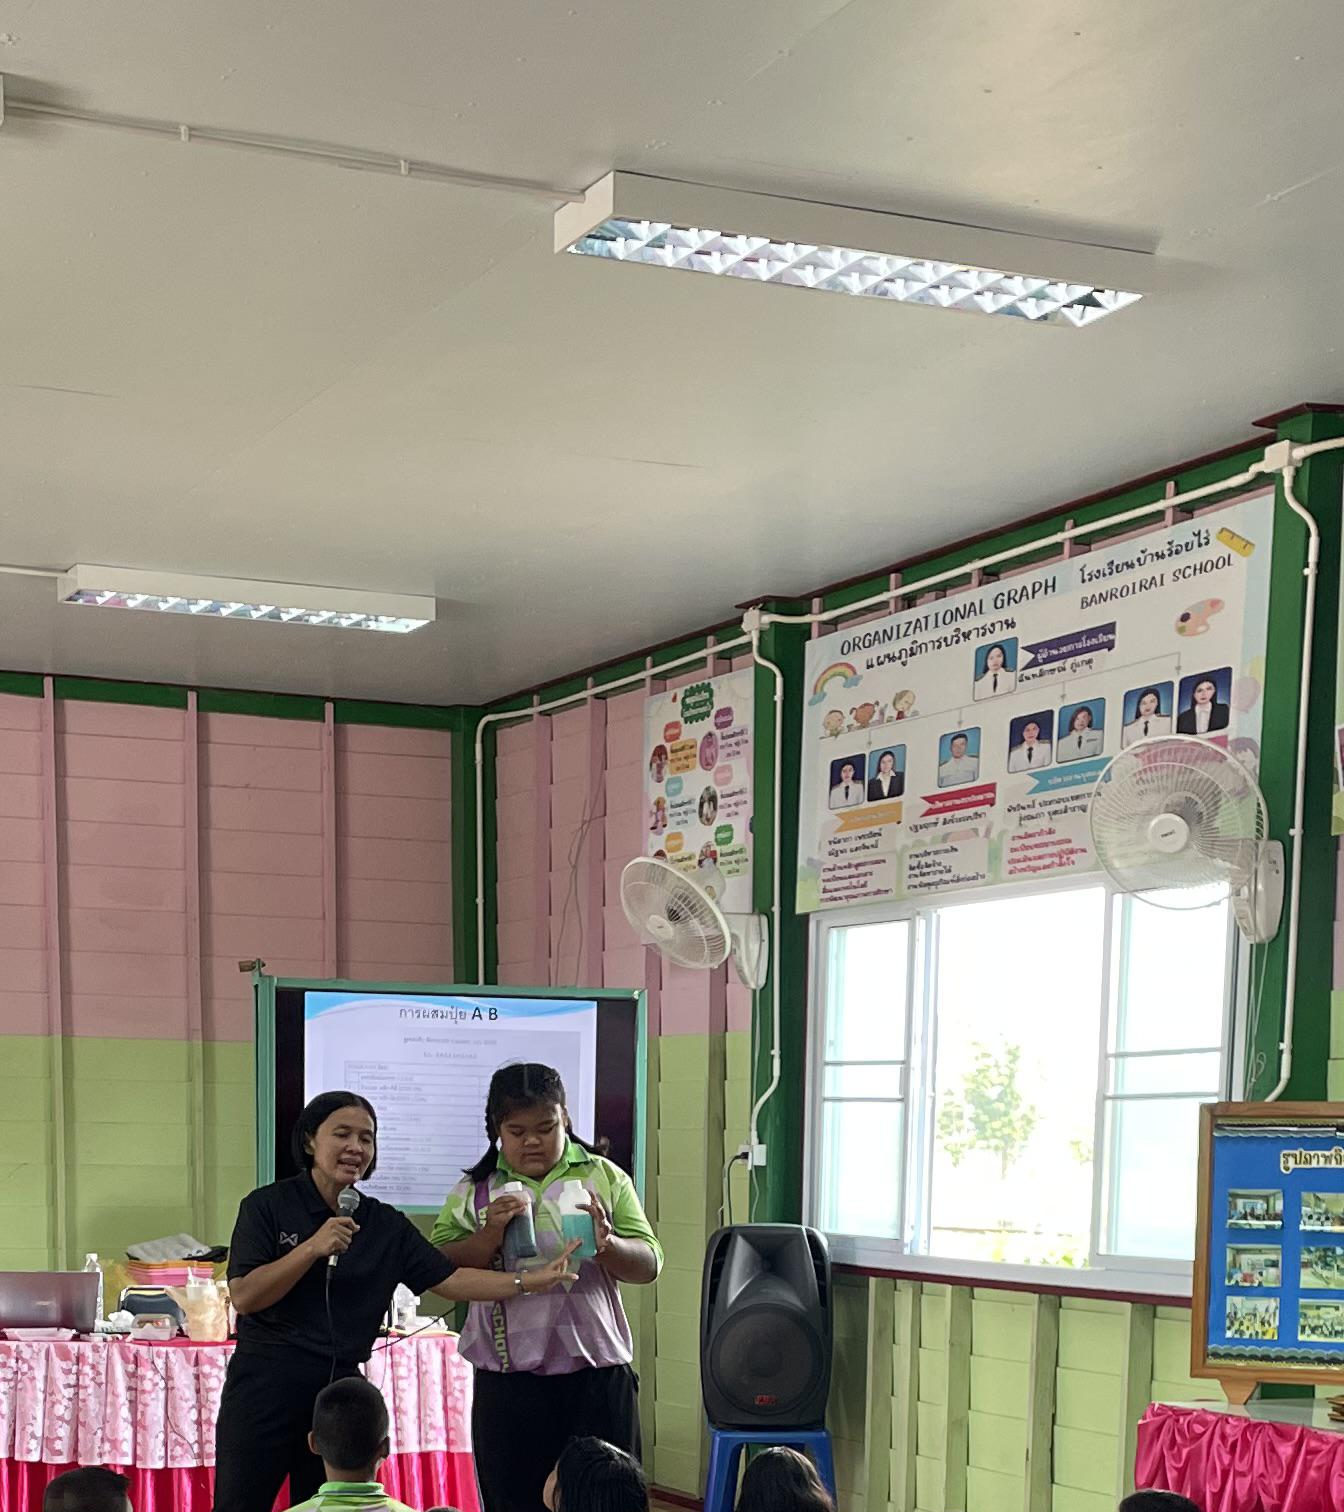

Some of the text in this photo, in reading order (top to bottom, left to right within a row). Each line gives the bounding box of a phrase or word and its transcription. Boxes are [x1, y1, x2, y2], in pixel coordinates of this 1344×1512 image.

[1080, 529, 1211, 584] โรงเรียนบ้านร้อยไร่
[1080, 553, 1234, 610] BANROIRAI SCHOOL
[841, 576, 1056, 656] ORGANIZATIONAL GRAPH
[866, 617, 1016, 669] แผนภูมิการบริหารงาน
[399, 1005, 498, 1025] การผสมปุ๋ย A B
